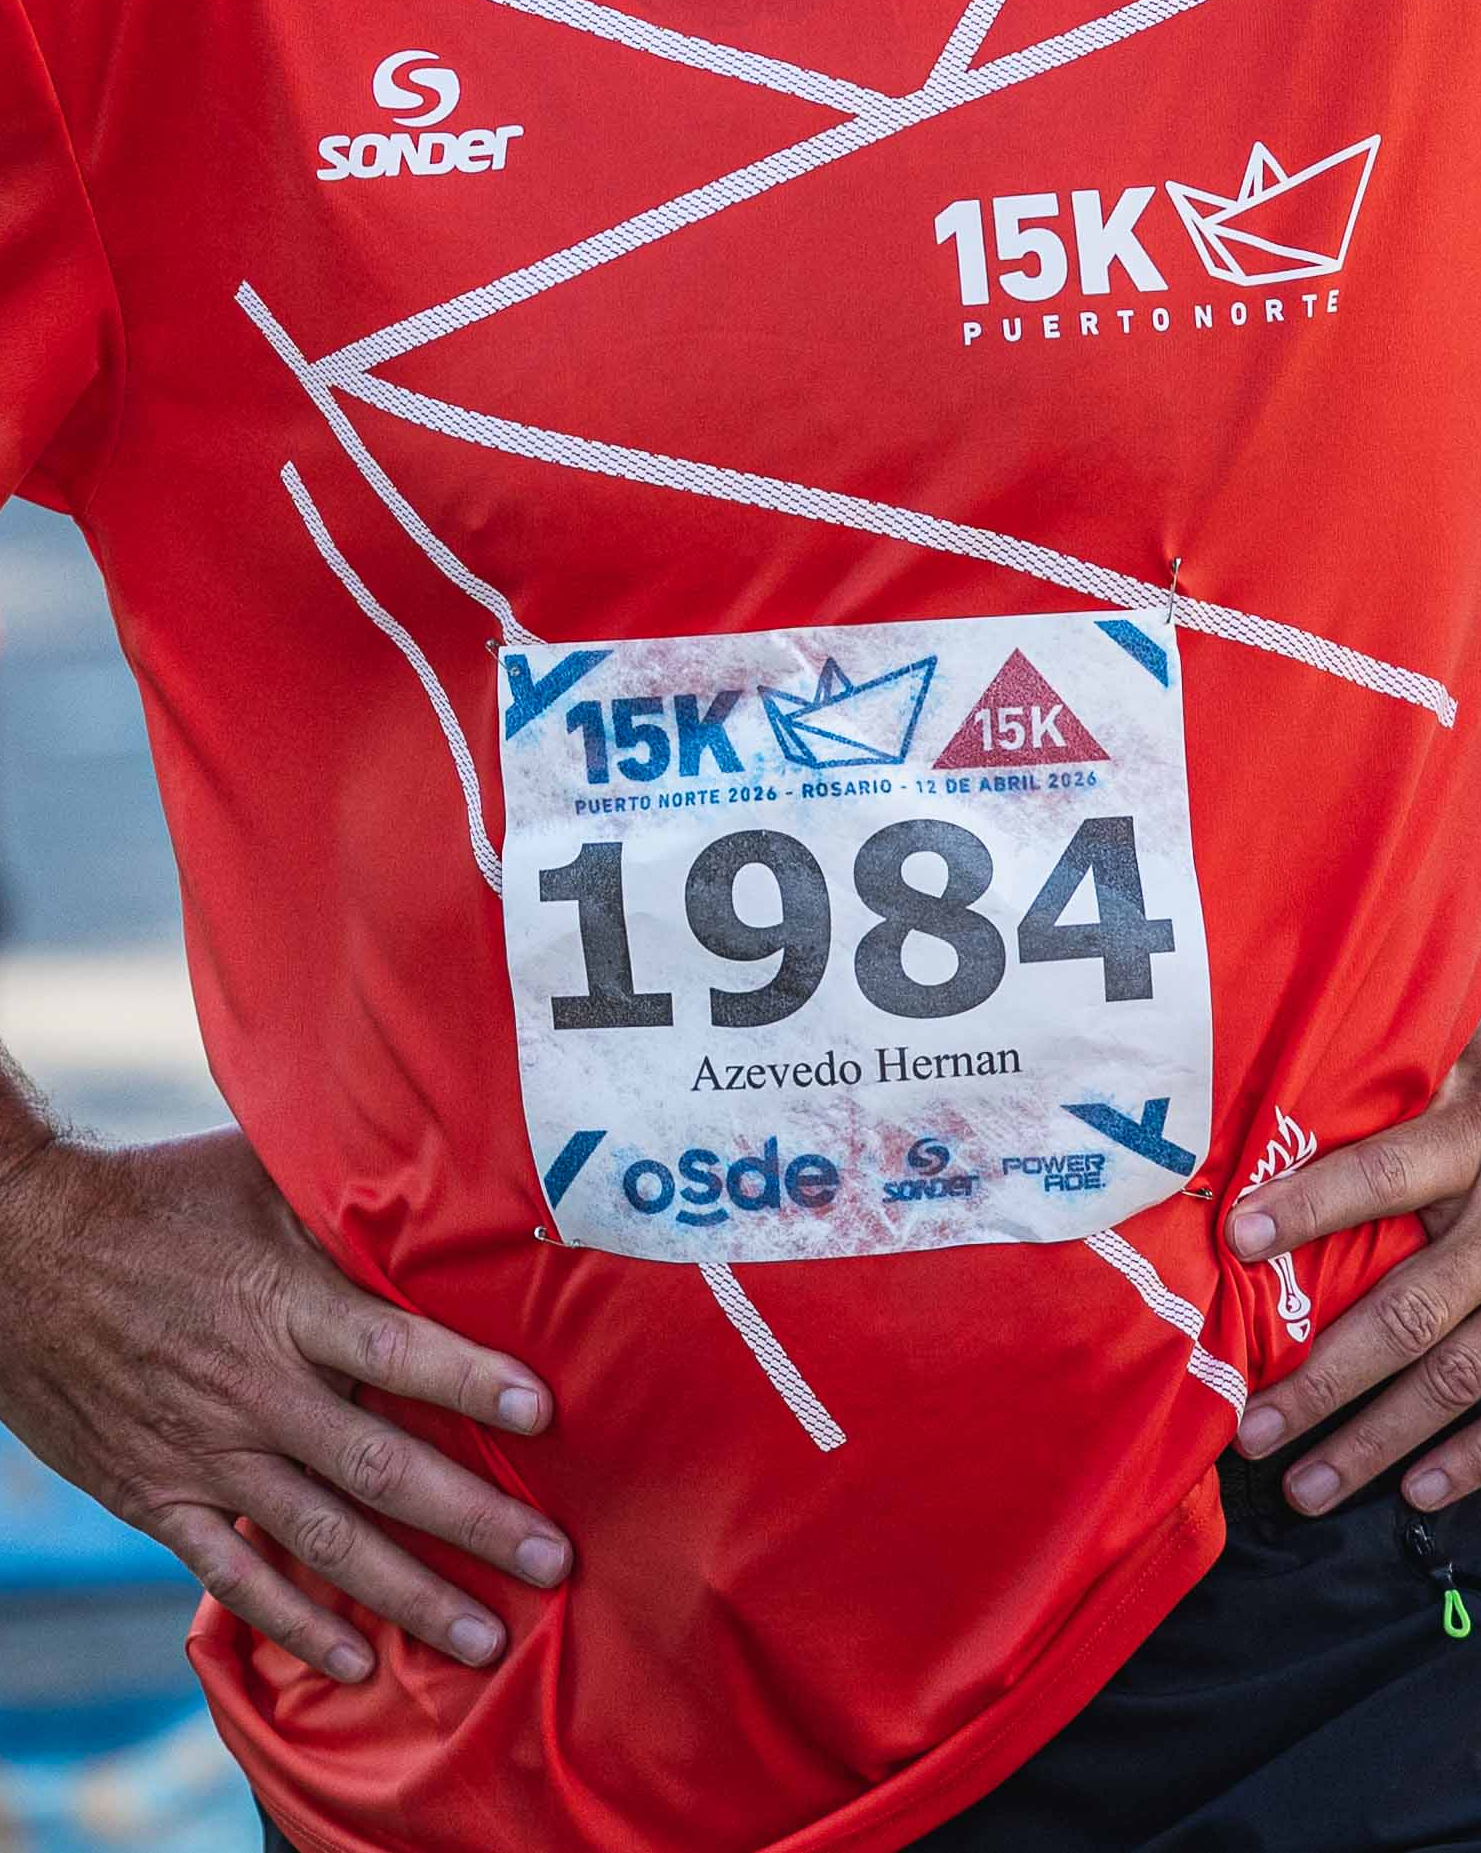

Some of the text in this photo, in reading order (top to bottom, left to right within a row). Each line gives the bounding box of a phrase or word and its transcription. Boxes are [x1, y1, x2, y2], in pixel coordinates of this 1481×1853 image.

[934, 186, 1169, 306] 15K
[962, 288, 1342, 346] PUERTO NORTE
[565, 689, 745, 785] 15K
[974, 703, 1068, 752] 15K
[574, 795, 652, 817] PUERTO
[658, 788, 721, 810] NORTE
[728, 784, 778, 804] 2026
[801, 778, 893, 799] ROSARIO
[915, 780, 937, 795] 12
[945, 776, 972, 795] DE
[979, 773, 1043, 793] ABRIL
[1048, 770, 1098, 789] 2026
[538, 815, 1176, 1030] 1984
[690, 1046, 1023, 1091] Azevedo Hernan
[623, 1135, 840, 1227] osde
[1002, 1152, 1106, 1176] POWER
